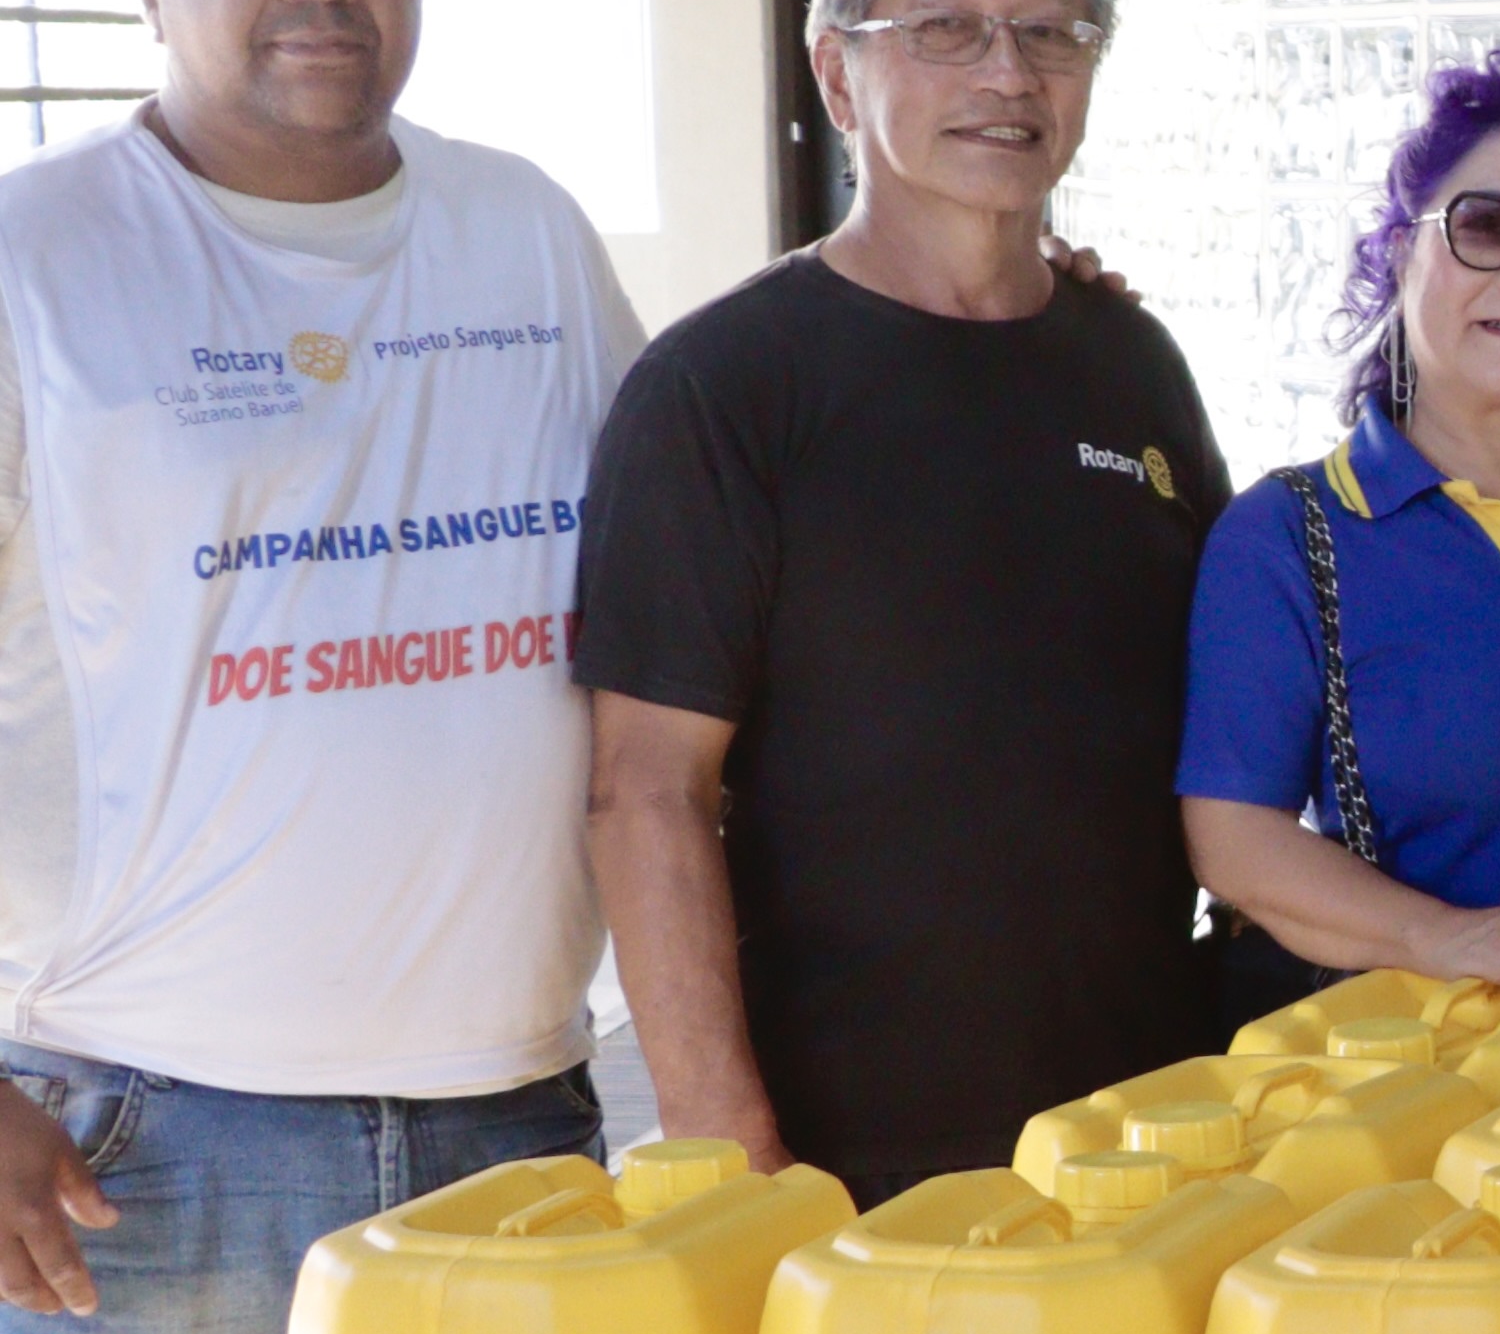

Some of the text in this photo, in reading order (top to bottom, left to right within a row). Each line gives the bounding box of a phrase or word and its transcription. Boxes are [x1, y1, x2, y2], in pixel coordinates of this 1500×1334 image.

[373, 331, 450, 359] Projeto
[455, 327, 526, 350] Sangue
[190, 347, 284, 375] Rotary
[154, 385, 199, 406] Club
[273, 379, 296, 396] de
[175, 397, 304, 427] Suzano Baruel
[1077, 442, 1144, 483] Rotary
[193, 523, 392, 580] CAMPANHA
[399, 501, 547, 553] SANGUE
[207, 644, 294, 707] DOE
[305, 625, 472, 695] SANGUE
[484, 614, 555, 676] DOE
